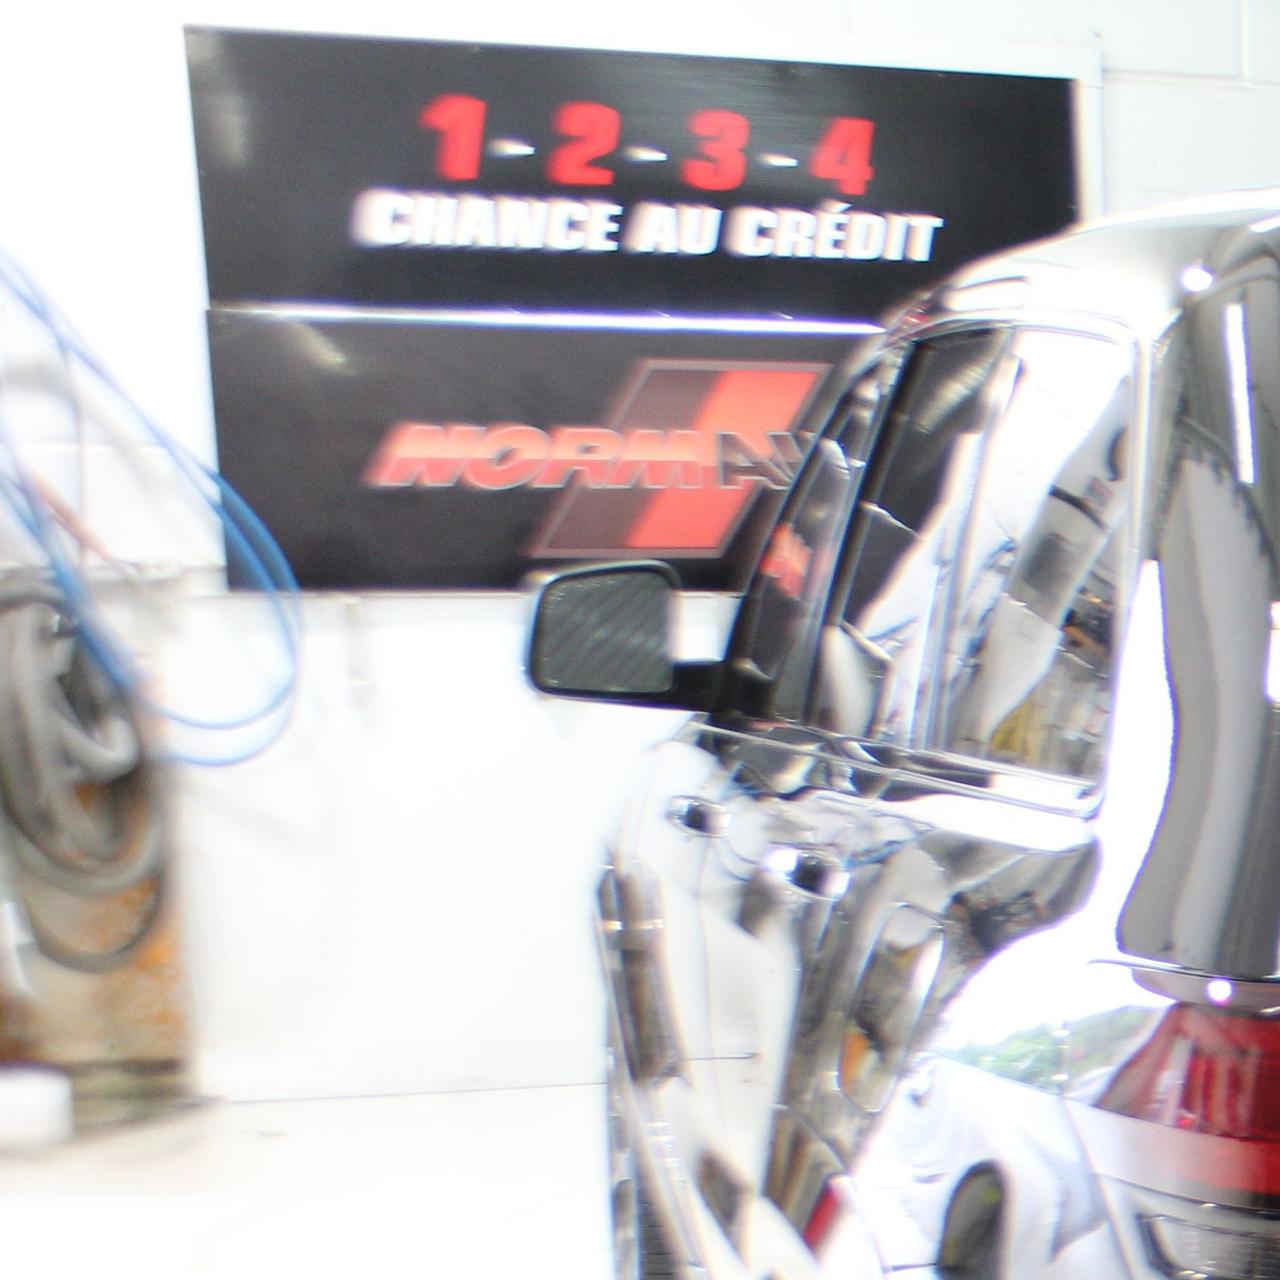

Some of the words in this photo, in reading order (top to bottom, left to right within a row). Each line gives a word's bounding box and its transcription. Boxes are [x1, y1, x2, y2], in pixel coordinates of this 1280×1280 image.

[354, 189, 623, 252] CHANCE
[625, 201, 723, 255] AU
[725, 200, 944, 263] CRÉDIT
